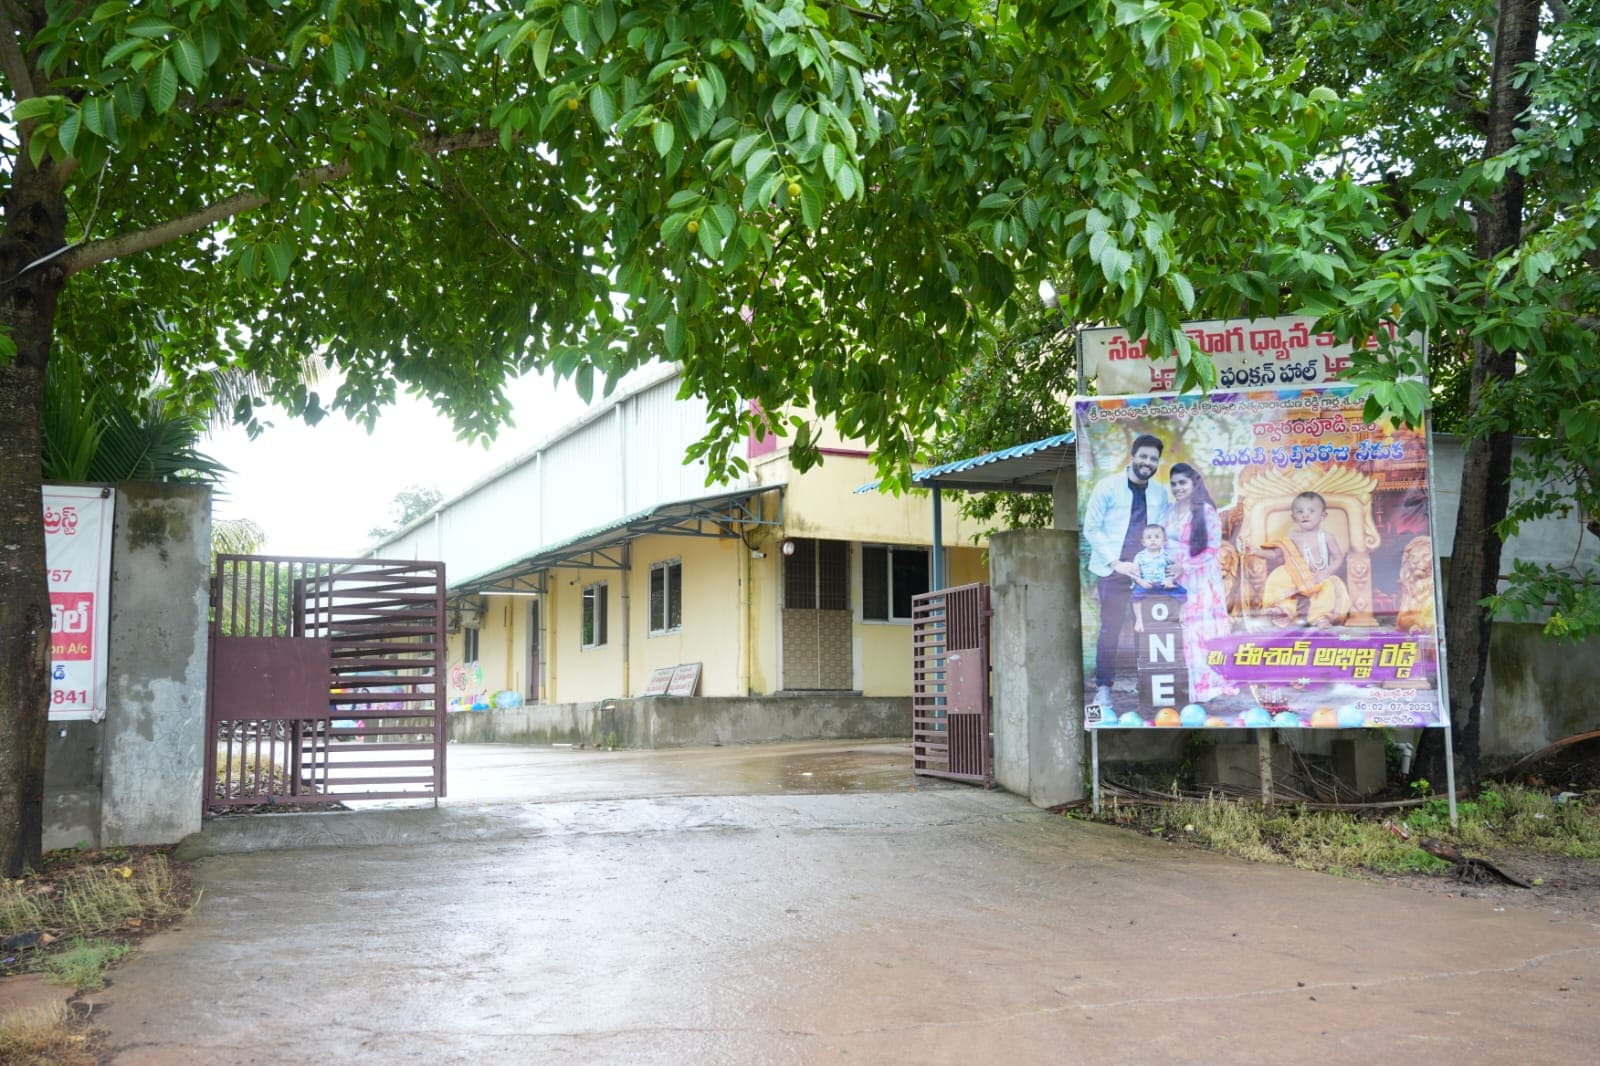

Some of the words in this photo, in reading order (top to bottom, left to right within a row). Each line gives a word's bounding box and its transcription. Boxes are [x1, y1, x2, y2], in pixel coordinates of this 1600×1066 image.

[1249, 323, 1309, 361] ధ్యాన
[1280, 360, 1317, 383] హాల్
[1253, 414, 1346, 440] ద్వారంపూడి
[1212, 447, 1266, 467] మొదటి
[1355, 439, 1406, 461] వేడుక
[68, 643, 88, 654] A/c
[1234, 641, 1312, 666] ఈశాన్
[1379, 641, 1418, 679] రెడ్డి
[51, 690, 87, 704] 841
